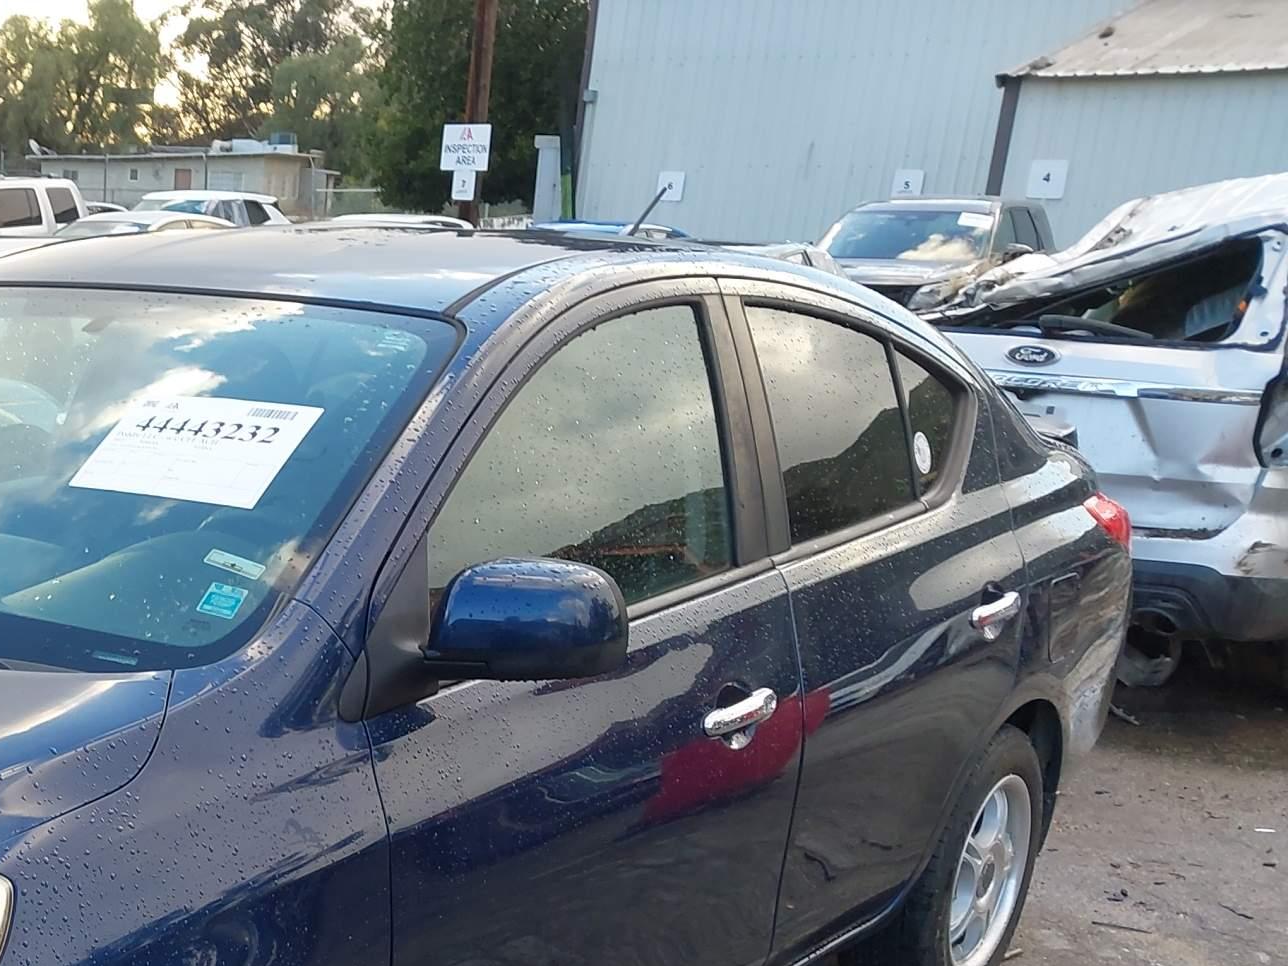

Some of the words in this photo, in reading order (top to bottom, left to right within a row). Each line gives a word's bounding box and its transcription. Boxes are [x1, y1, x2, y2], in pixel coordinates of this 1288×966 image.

[444, 143, 488, 154] INSPECTION
[455, 155, 477, 166] AREA
[1042, 171, 1051, 183] 4
[667, 181, 674, 190] 6
[903, 180, 911, 190] 5
[1014, 346, 1049, 363] Ford
[136, 415, 281, 444] 44443232
